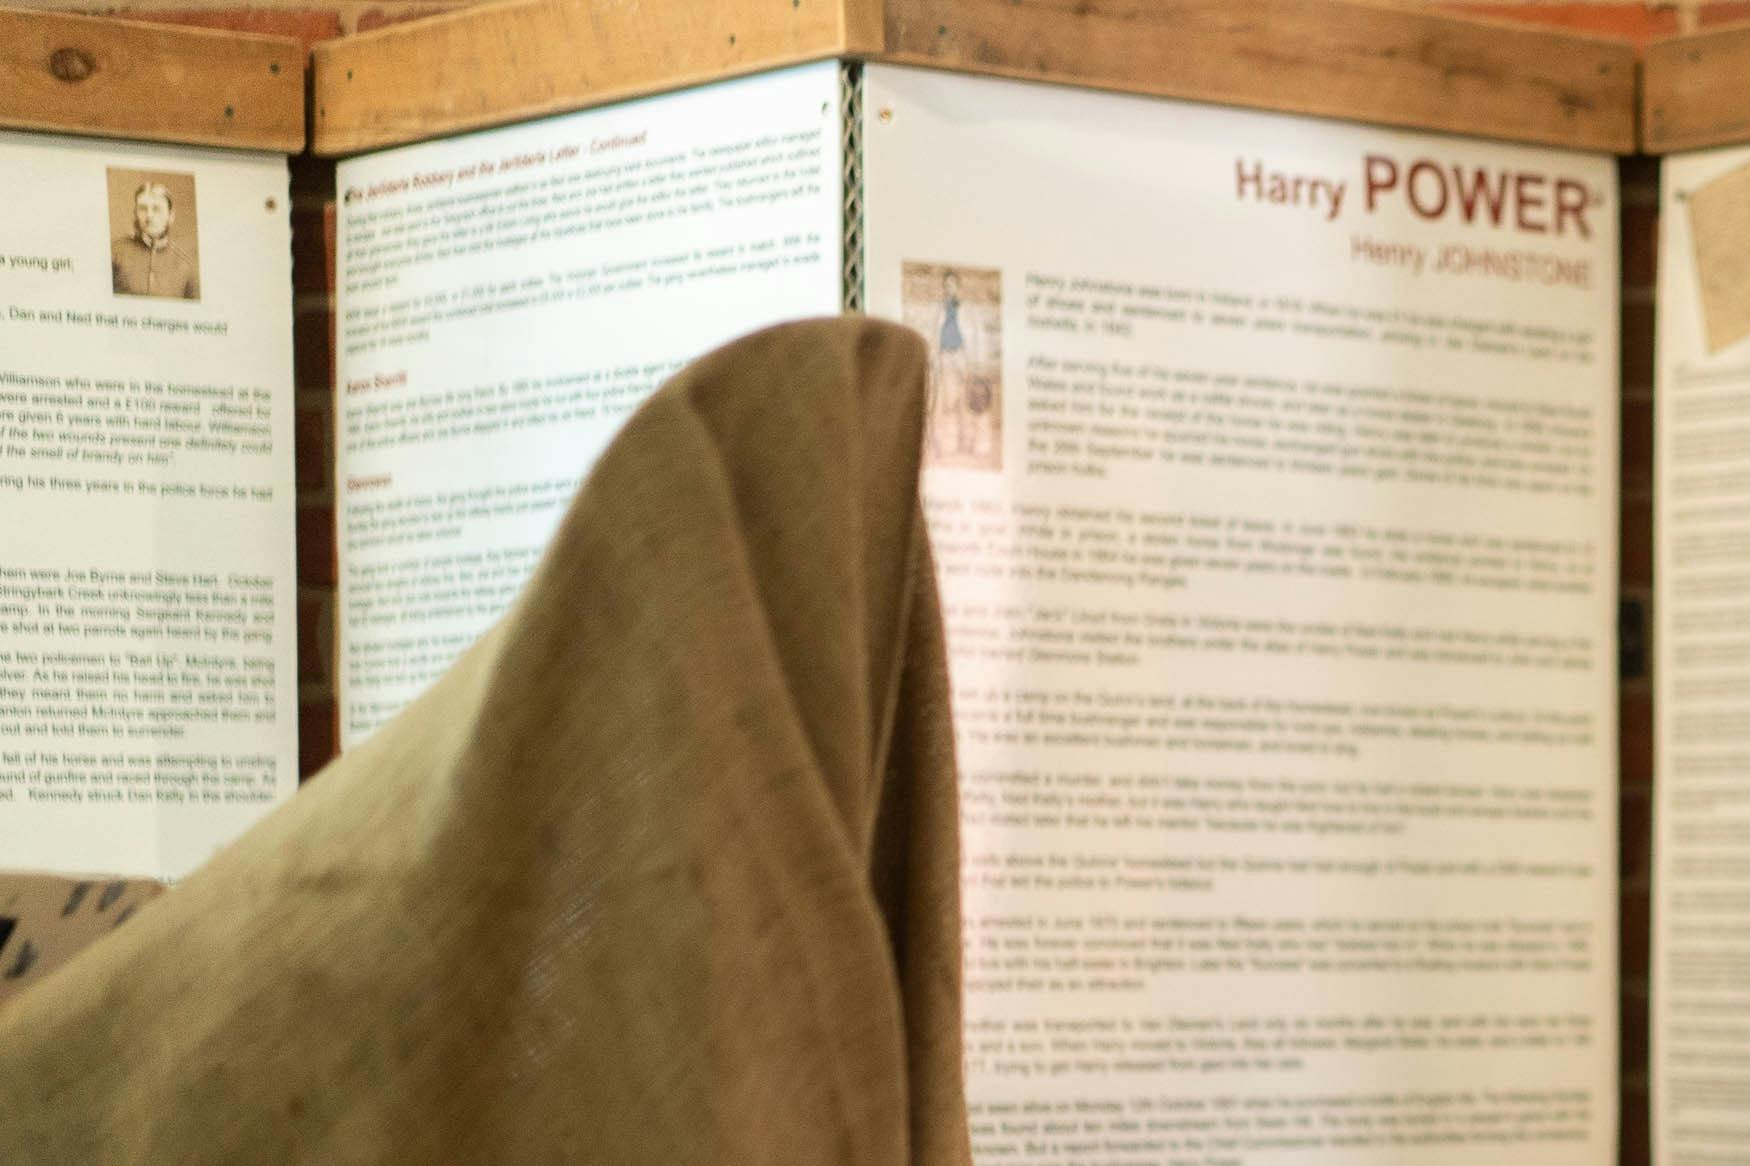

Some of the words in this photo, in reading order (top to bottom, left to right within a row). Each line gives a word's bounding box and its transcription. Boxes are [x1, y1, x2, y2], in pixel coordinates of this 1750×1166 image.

[1234, 158, 1347, 219] Harry
[1362, 153, 1592, 241] POWER
[1350, 233, 1431, 277] Henry
[1435, 242, 1592, 290] JOHNSTONE
